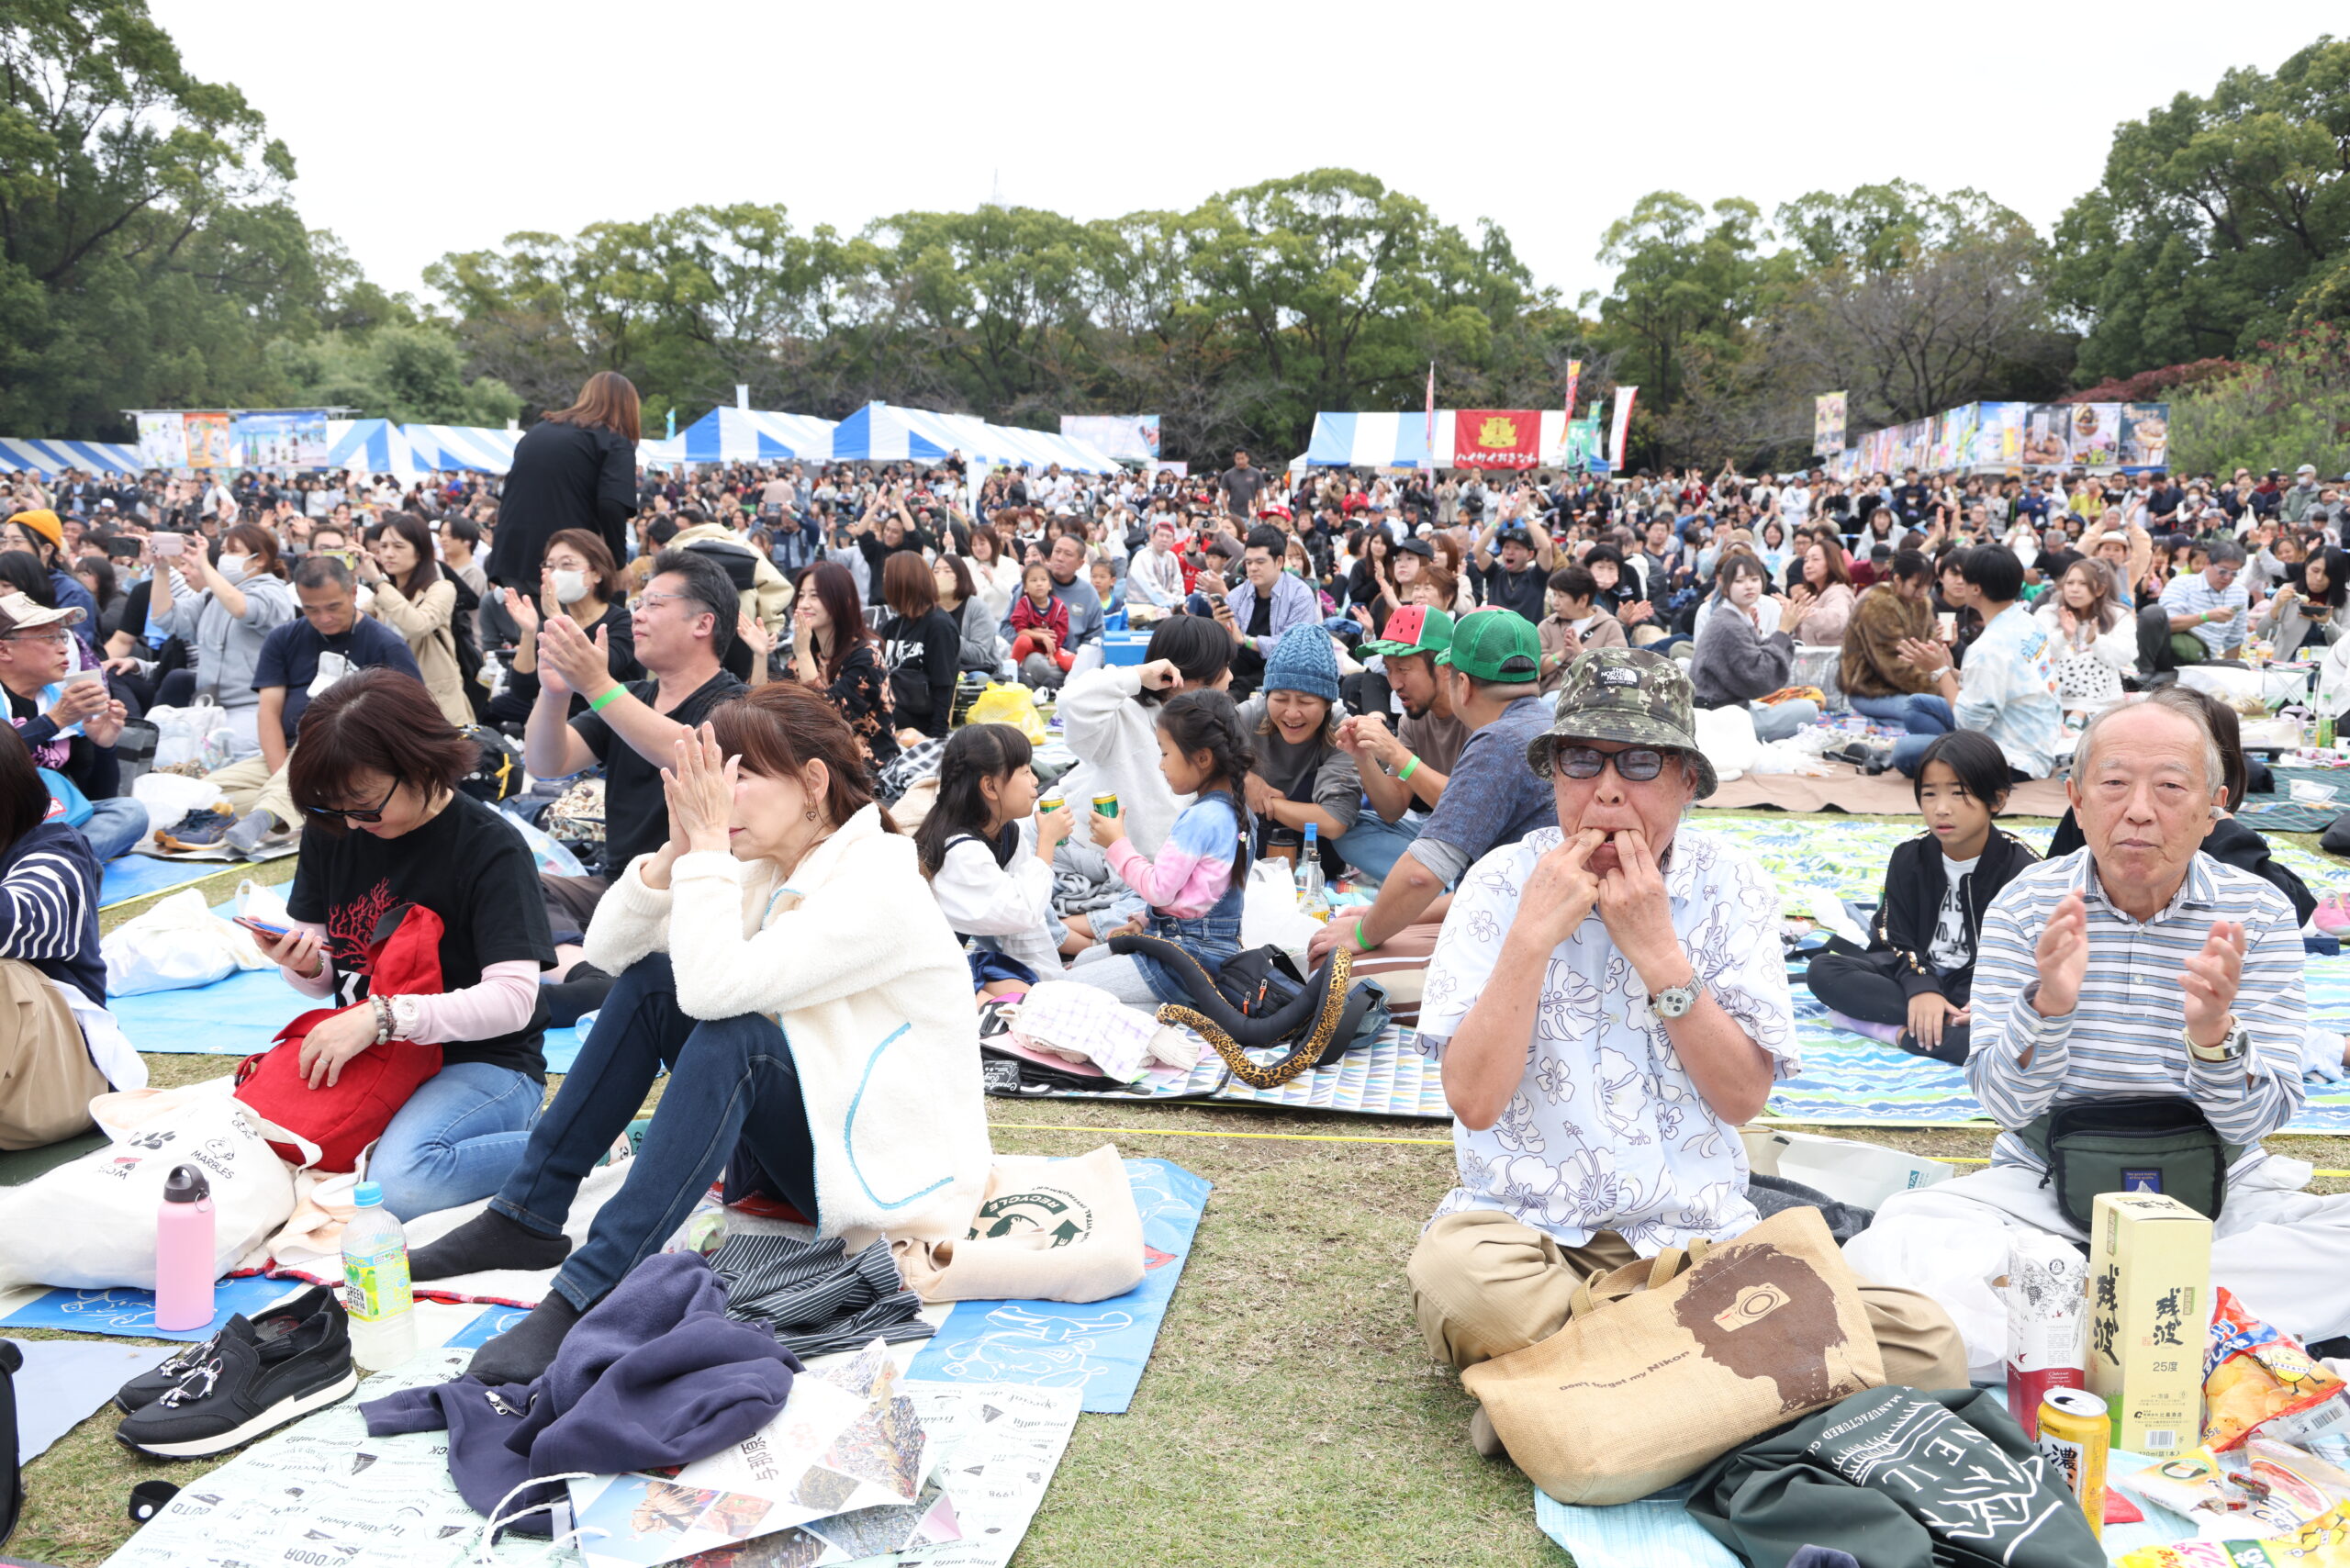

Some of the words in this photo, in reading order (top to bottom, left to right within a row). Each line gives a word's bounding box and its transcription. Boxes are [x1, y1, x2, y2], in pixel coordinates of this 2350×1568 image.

[1456, 452, 1538, 464] ハイサイおきなわ
[190, 1149, 235, 1180] MARBLES
[989, 1195, 1060, 1211] RECYCLE
[346, 1284, 364, 1302] GREEN
[2093, 1263, 2120, 1366] 残波
[2153, 1287, 2184, 1346] 残波
[1559, 1381, 1590, 1391] Don't
[1592, 1379, 1628, 1389] forget
[1629, 1372, 1647, 1382] my
[1646, 1350, 1691, 1373] Nikon
[2153, 1361, 2178, 1372] 25度
[1822, 1394, 1904, 1440] MANUFACTURED
[2202, 1425, 2222, 1441] 55g
[989, 1490, 1015, 1498] 1998
